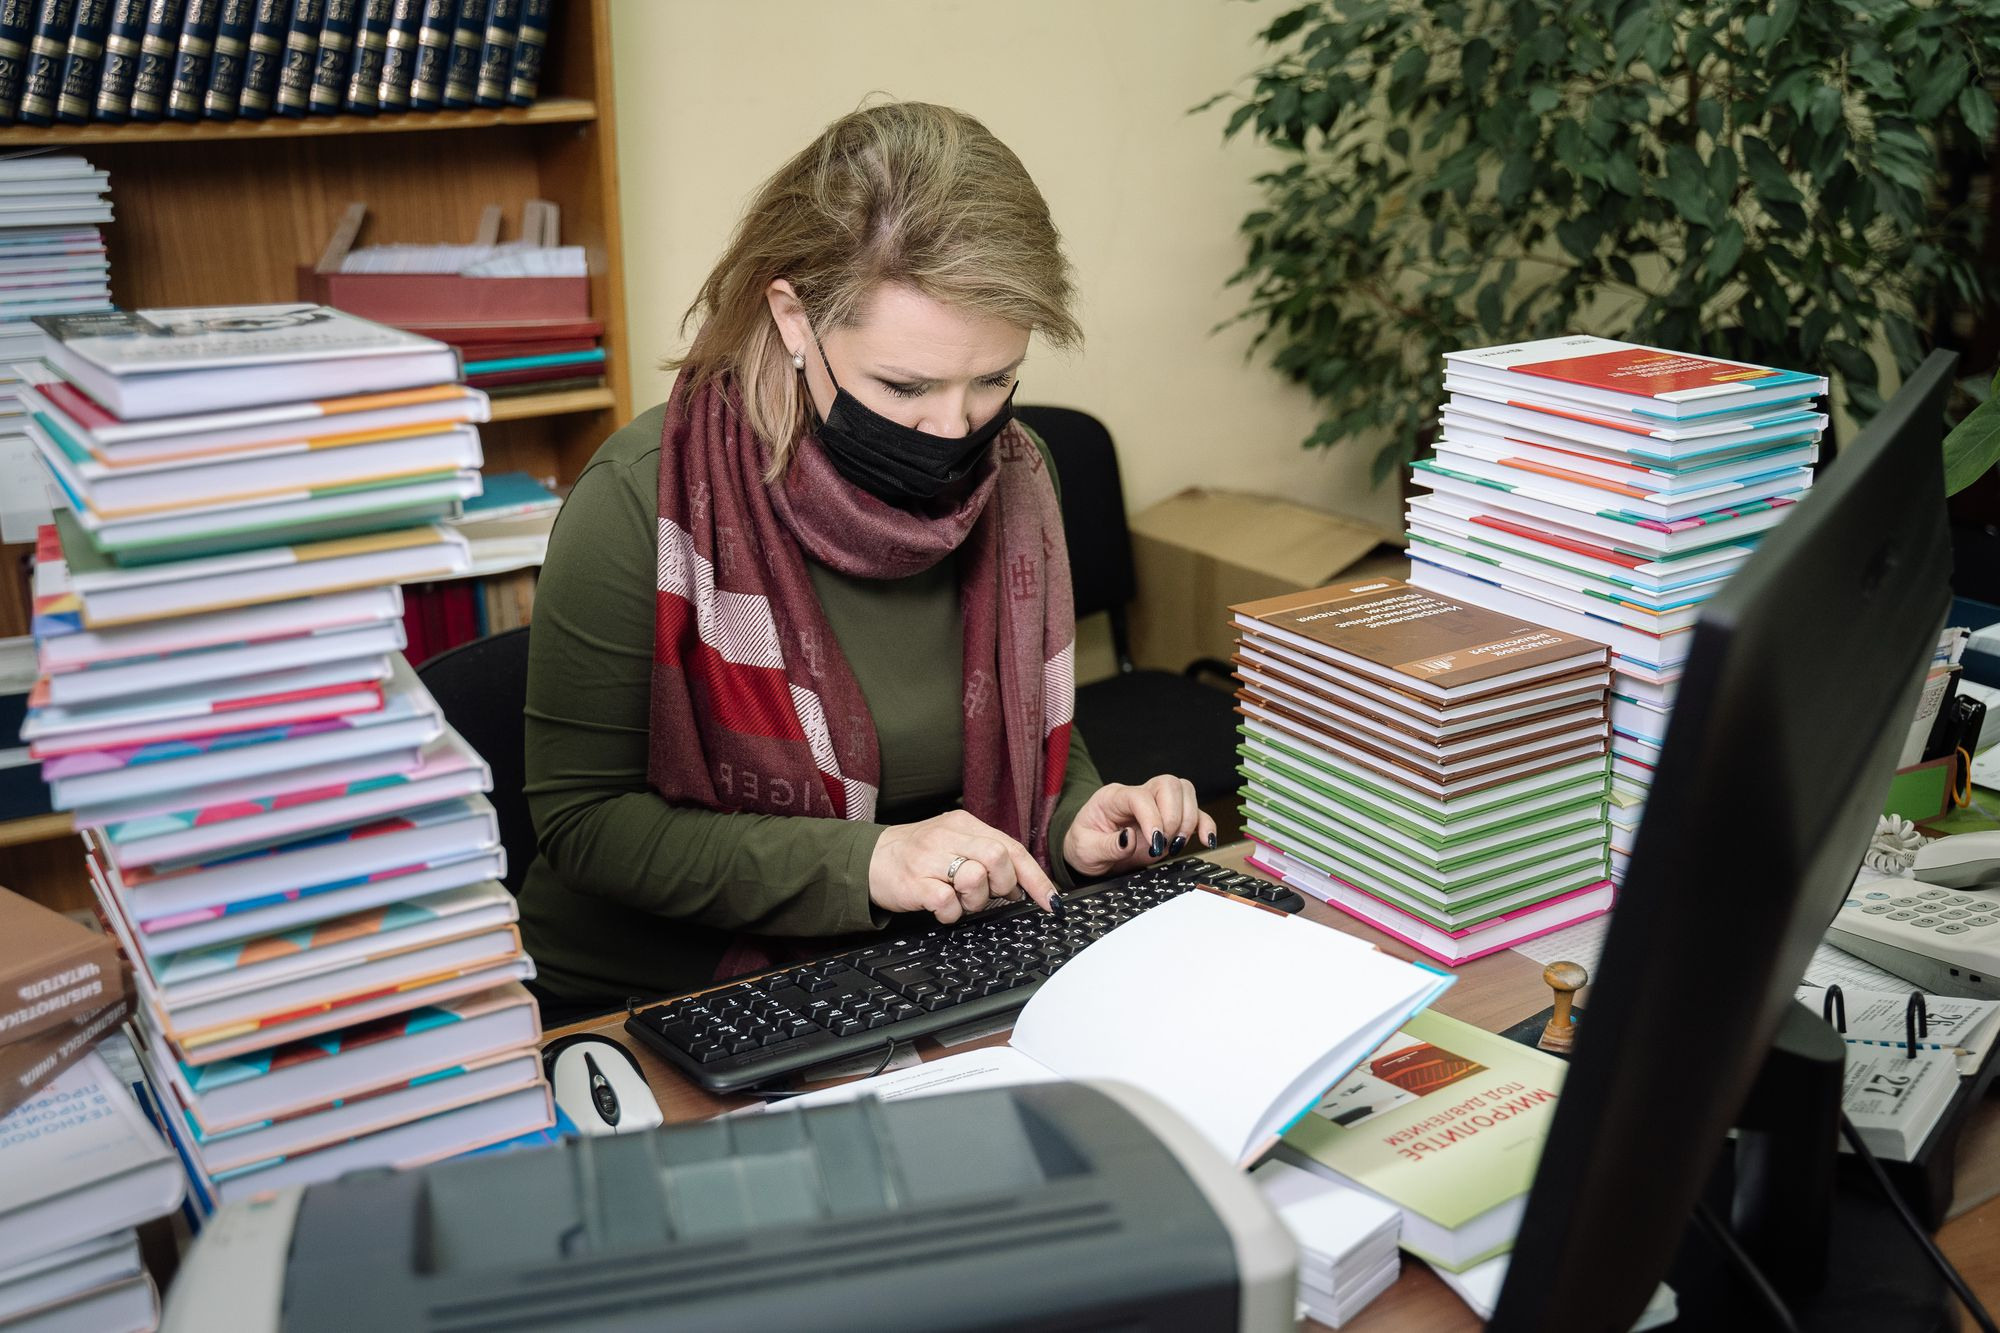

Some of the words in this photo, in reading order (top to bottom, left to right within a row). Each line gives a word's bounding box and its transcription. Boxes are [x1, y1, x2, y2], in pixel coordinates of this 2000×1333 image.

[1339, 593, 1423, 614] продвижения
[1365, 598, 1436, 615] технологии
[1296, 609, 1341, 623] чтения
[1335, 603, 1439, 629] мультимедийные
[1365, 605, 1463, 629] Интерактивные
[1468, 632, 1551, 655] БИБЛИОТЕКАРЯ
[1490, 637, 1563, 657] СПРАВОЧНИК
[17, 962, 100, 1000] ЧИТАТЕЛЬ
[1482, 1081, 1526, 1101] ПОД
[1863, 1074, 1911, 1098] 27
[1383, 1099, 1487, 1147] ДАВЛЕНИЕМ
[1397, 1087, 1558, 1163] МИКРОЛИТЬЕ
